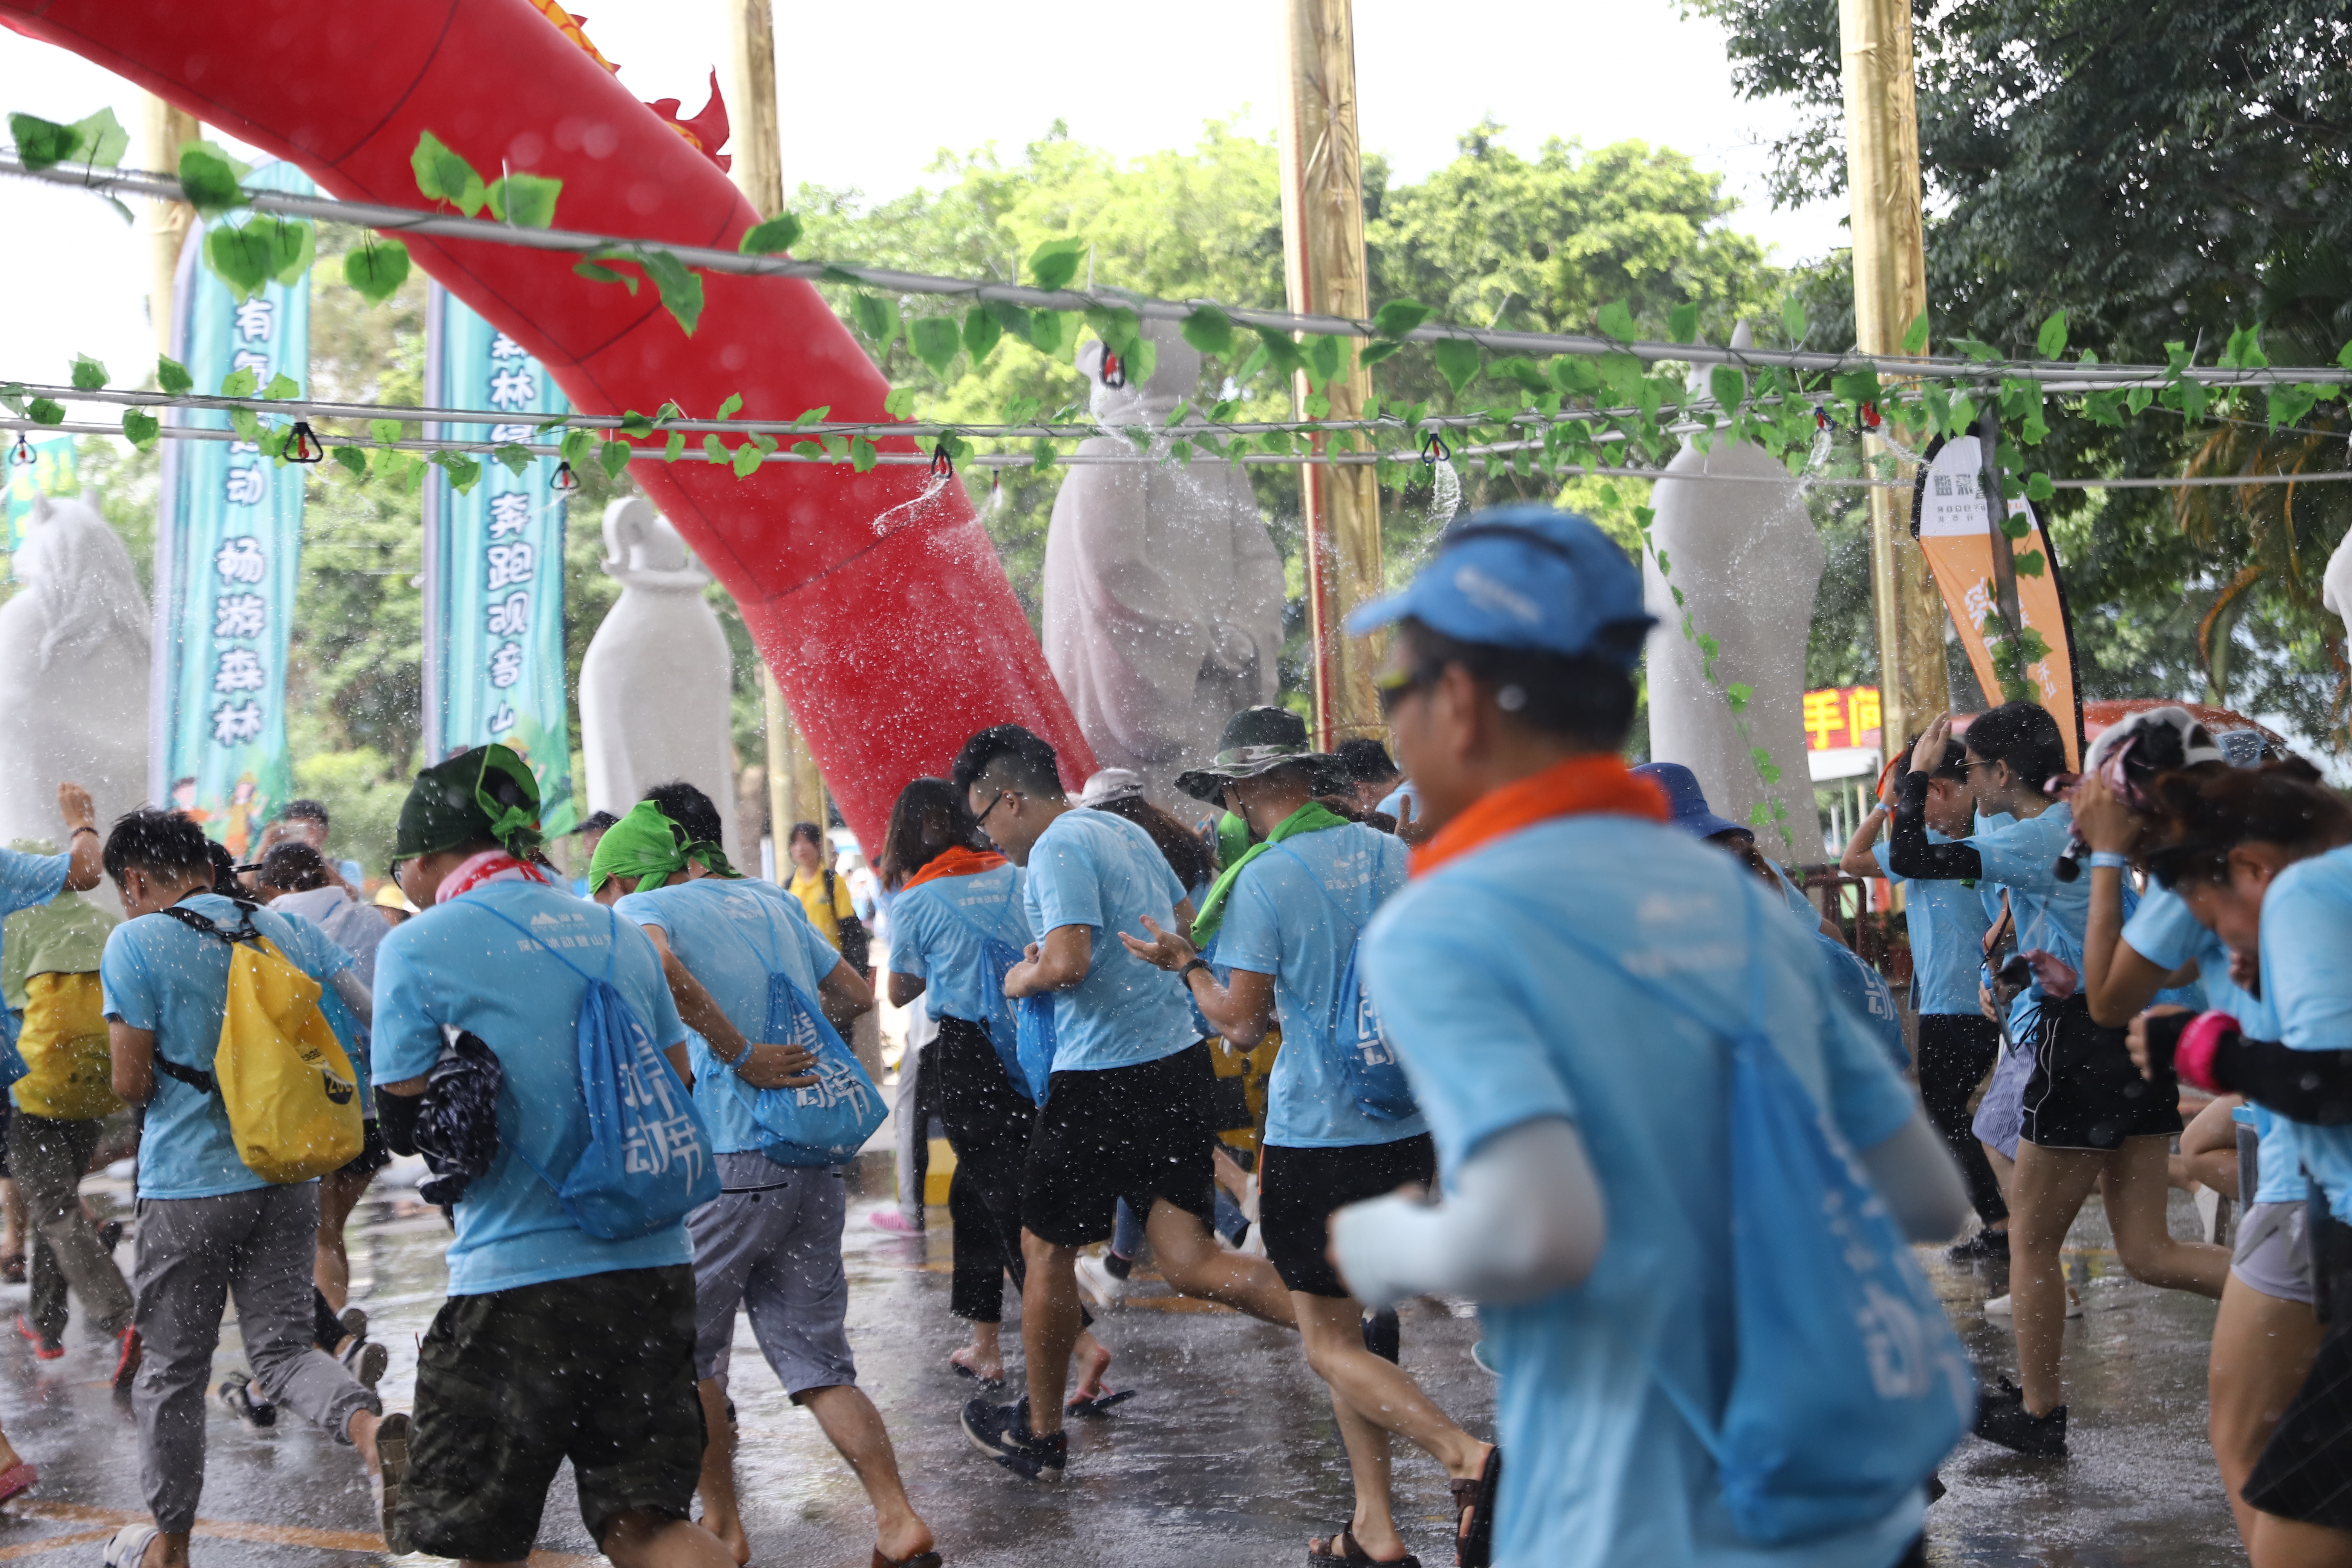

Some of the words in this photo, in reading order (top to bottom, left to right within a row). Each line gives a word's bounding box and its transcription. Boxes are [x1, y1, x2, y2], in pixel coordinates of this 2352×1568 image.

[488, 492, 533, 733] 奔跑观音山
